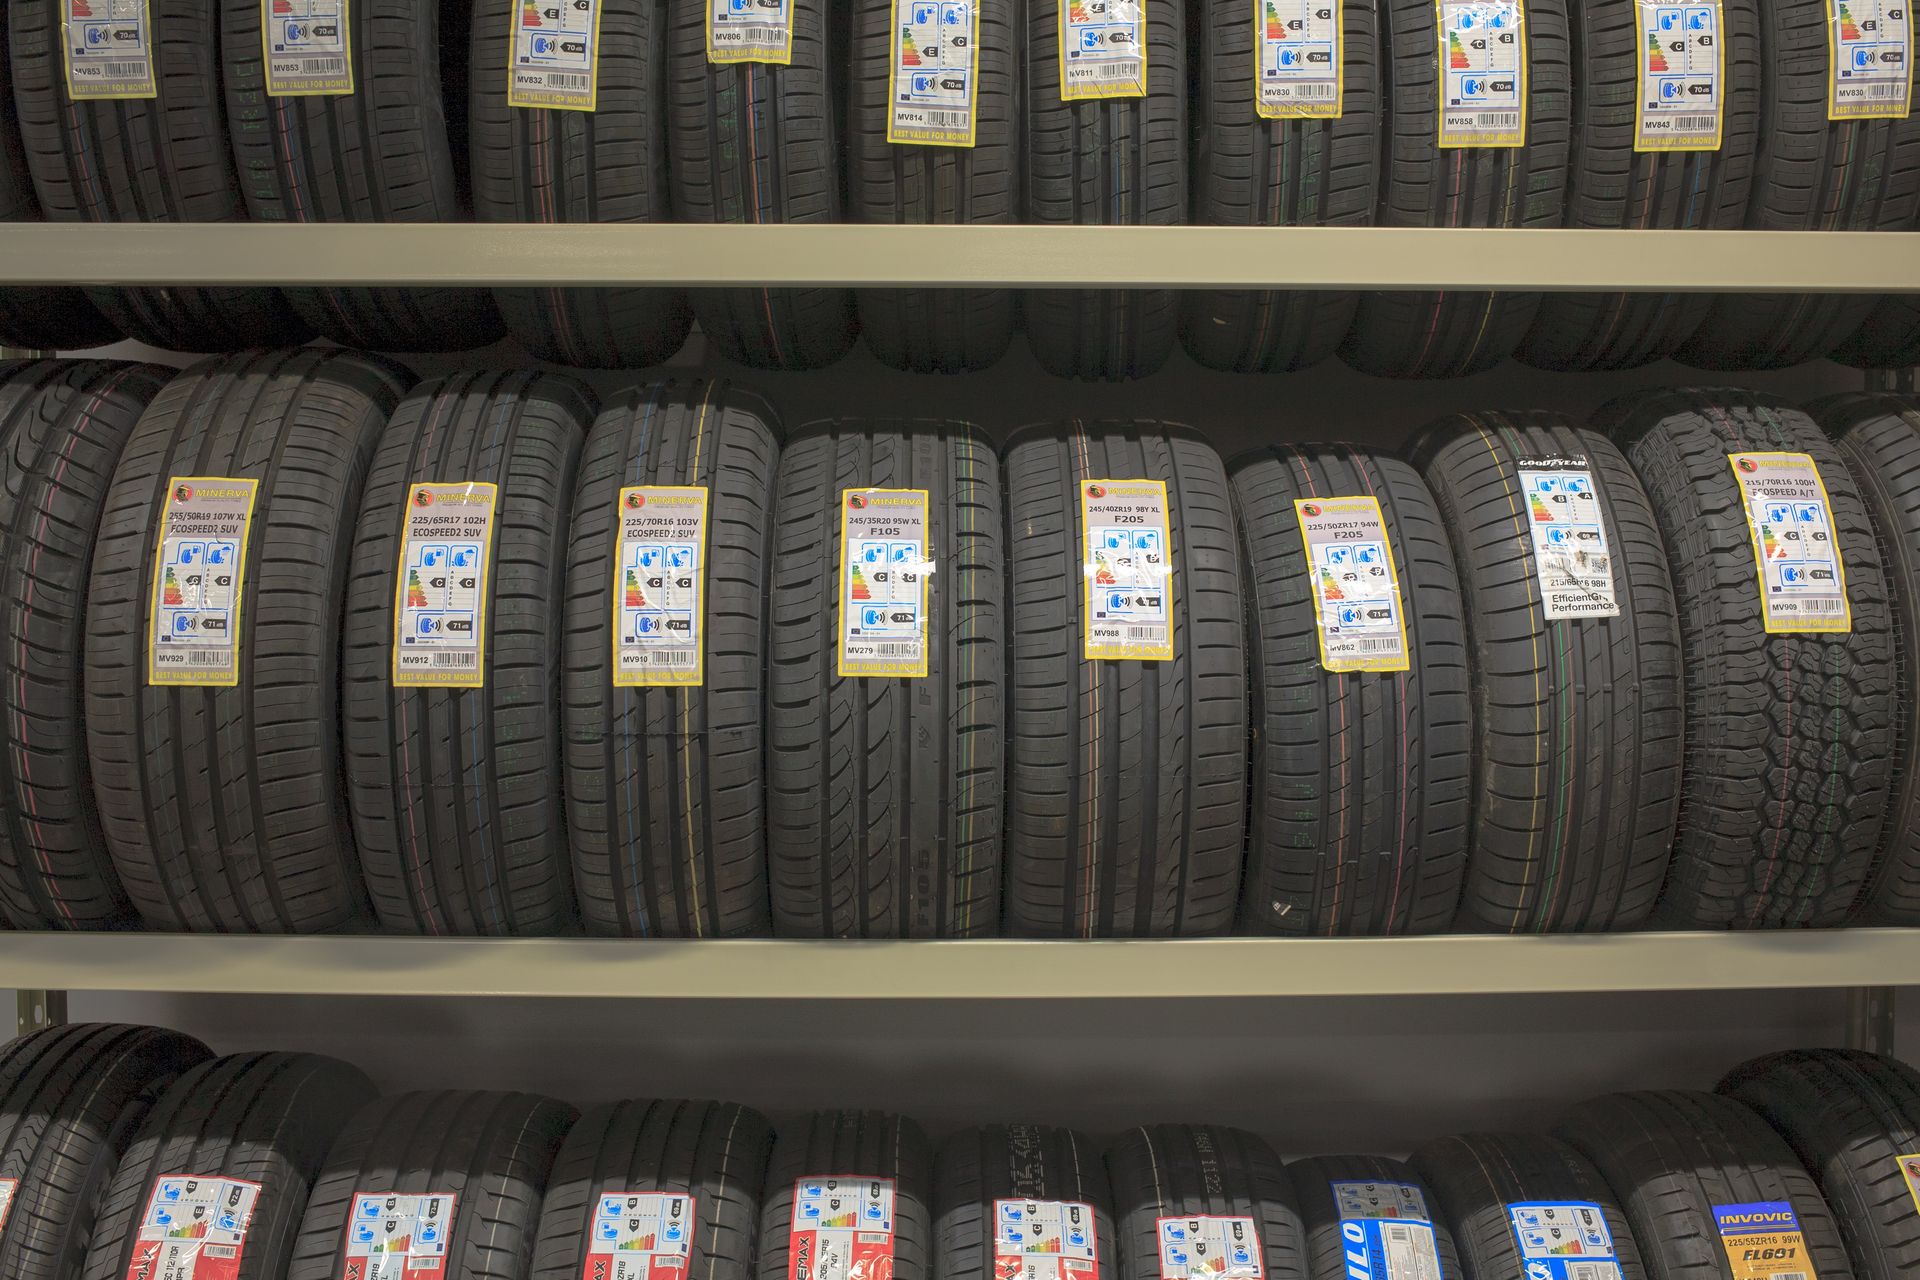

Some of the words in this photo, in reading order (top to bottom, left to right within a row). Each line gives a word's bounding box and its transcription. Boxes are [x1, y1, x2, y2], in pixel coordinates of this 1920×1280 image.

[549, 10, 556, 18] E
[1293, 21, 1299, 29] E
[1866, 21, 1873, 29] E
[715, 33, 741, 41] MV806
[1504, 34, 1511, 42] B
[1703, 37, 1710, 45] B
[957, 38, 964, 46] C
[1675, 43, 1682, 51] C
[928, 48, 935, 56] E
[273, 63, 299, 72] MV853
[1069, 69, 1093, 78] MV811
[517, 75, 542, 85] MV832
[1264, 88, 1290, 97] MV830
[1838, 89, 1863, 97] MV830
[897, 113, 923, 122] MV814
[1447, 117, 1473, 126] MV858
[1645, 120, 1670, 129] MV843
[1744, 478, 1792, 486] 215/70R16
[1794, 479, 1816, 487] 100H
[195, 488, 250, 498] MINERVA
[1799, 488, 1815, 498] A/T
[435, 494, 491, 504] MINERVA
[647, 496, 703, 505] MINERVA
[870, 497, 923, 506] MINERVA
[1557, 495, 1564, 503] B
[1088, 505, 1132, 514] 245/40ZR19
[1135, 506, 1149, 514] 98Y
[1151, 506, 1160, 514] XL
[169, 511, 211, 522] 255/50R19
[213, 512, 234, 521] 107W
[236, 512, 246, 521] XL
[1114, 515, 1145, 525] F205
[412, 516, 461, 528] 225/65R17
[463, 516, 486, 526] 102H
[625, 518, 674, 528] 225/70R16
[677, 518, 699, 527] 103V
[849, 517, 891, 527] 245/35R20
[892, 517, 909, 526] 95W
[911, 518, 921, 526] XL
[1307, 521, 1358, 531] 225/50ZR17
[1360, 521, 1379, 529] 94W
[220, 524, 238, 534] SUV
[413, 528, 461, 538] ECOSPEED2
[463, 528, 482, 538] SUV
[870, 527, 900, 537] F105
[627, 529, 675, 539] ECOSPEED2
[678, 529, 696, 539] SUV
[1334, 530, 1364, 540] F205
[221, 576, 227, 585] C
[436, 579, 443, 587] C
[465, 579, 472, 587] C
[653, 579, 660, 587] C
[682, 579, 689, 587] C
[1590, 579, 1606, 588] 98H
[1552, 602, 1614, 612] Performance
[1771, 603, 1797, 611] MV909
[1093, 629, 1119, 638] MV988
[847, 646, 874, 655] MV279
[158, 653, 184, 662] MV929
[402, 656, 429, 664] MV912
[622, 655, 648, 664] MV910
[1720, 1212, 1792, 1224] INVOVIC
[1727, 1237, 1778, 1247] 225/55ZR16
[1782, 1236, 1800, 1244] 99W
